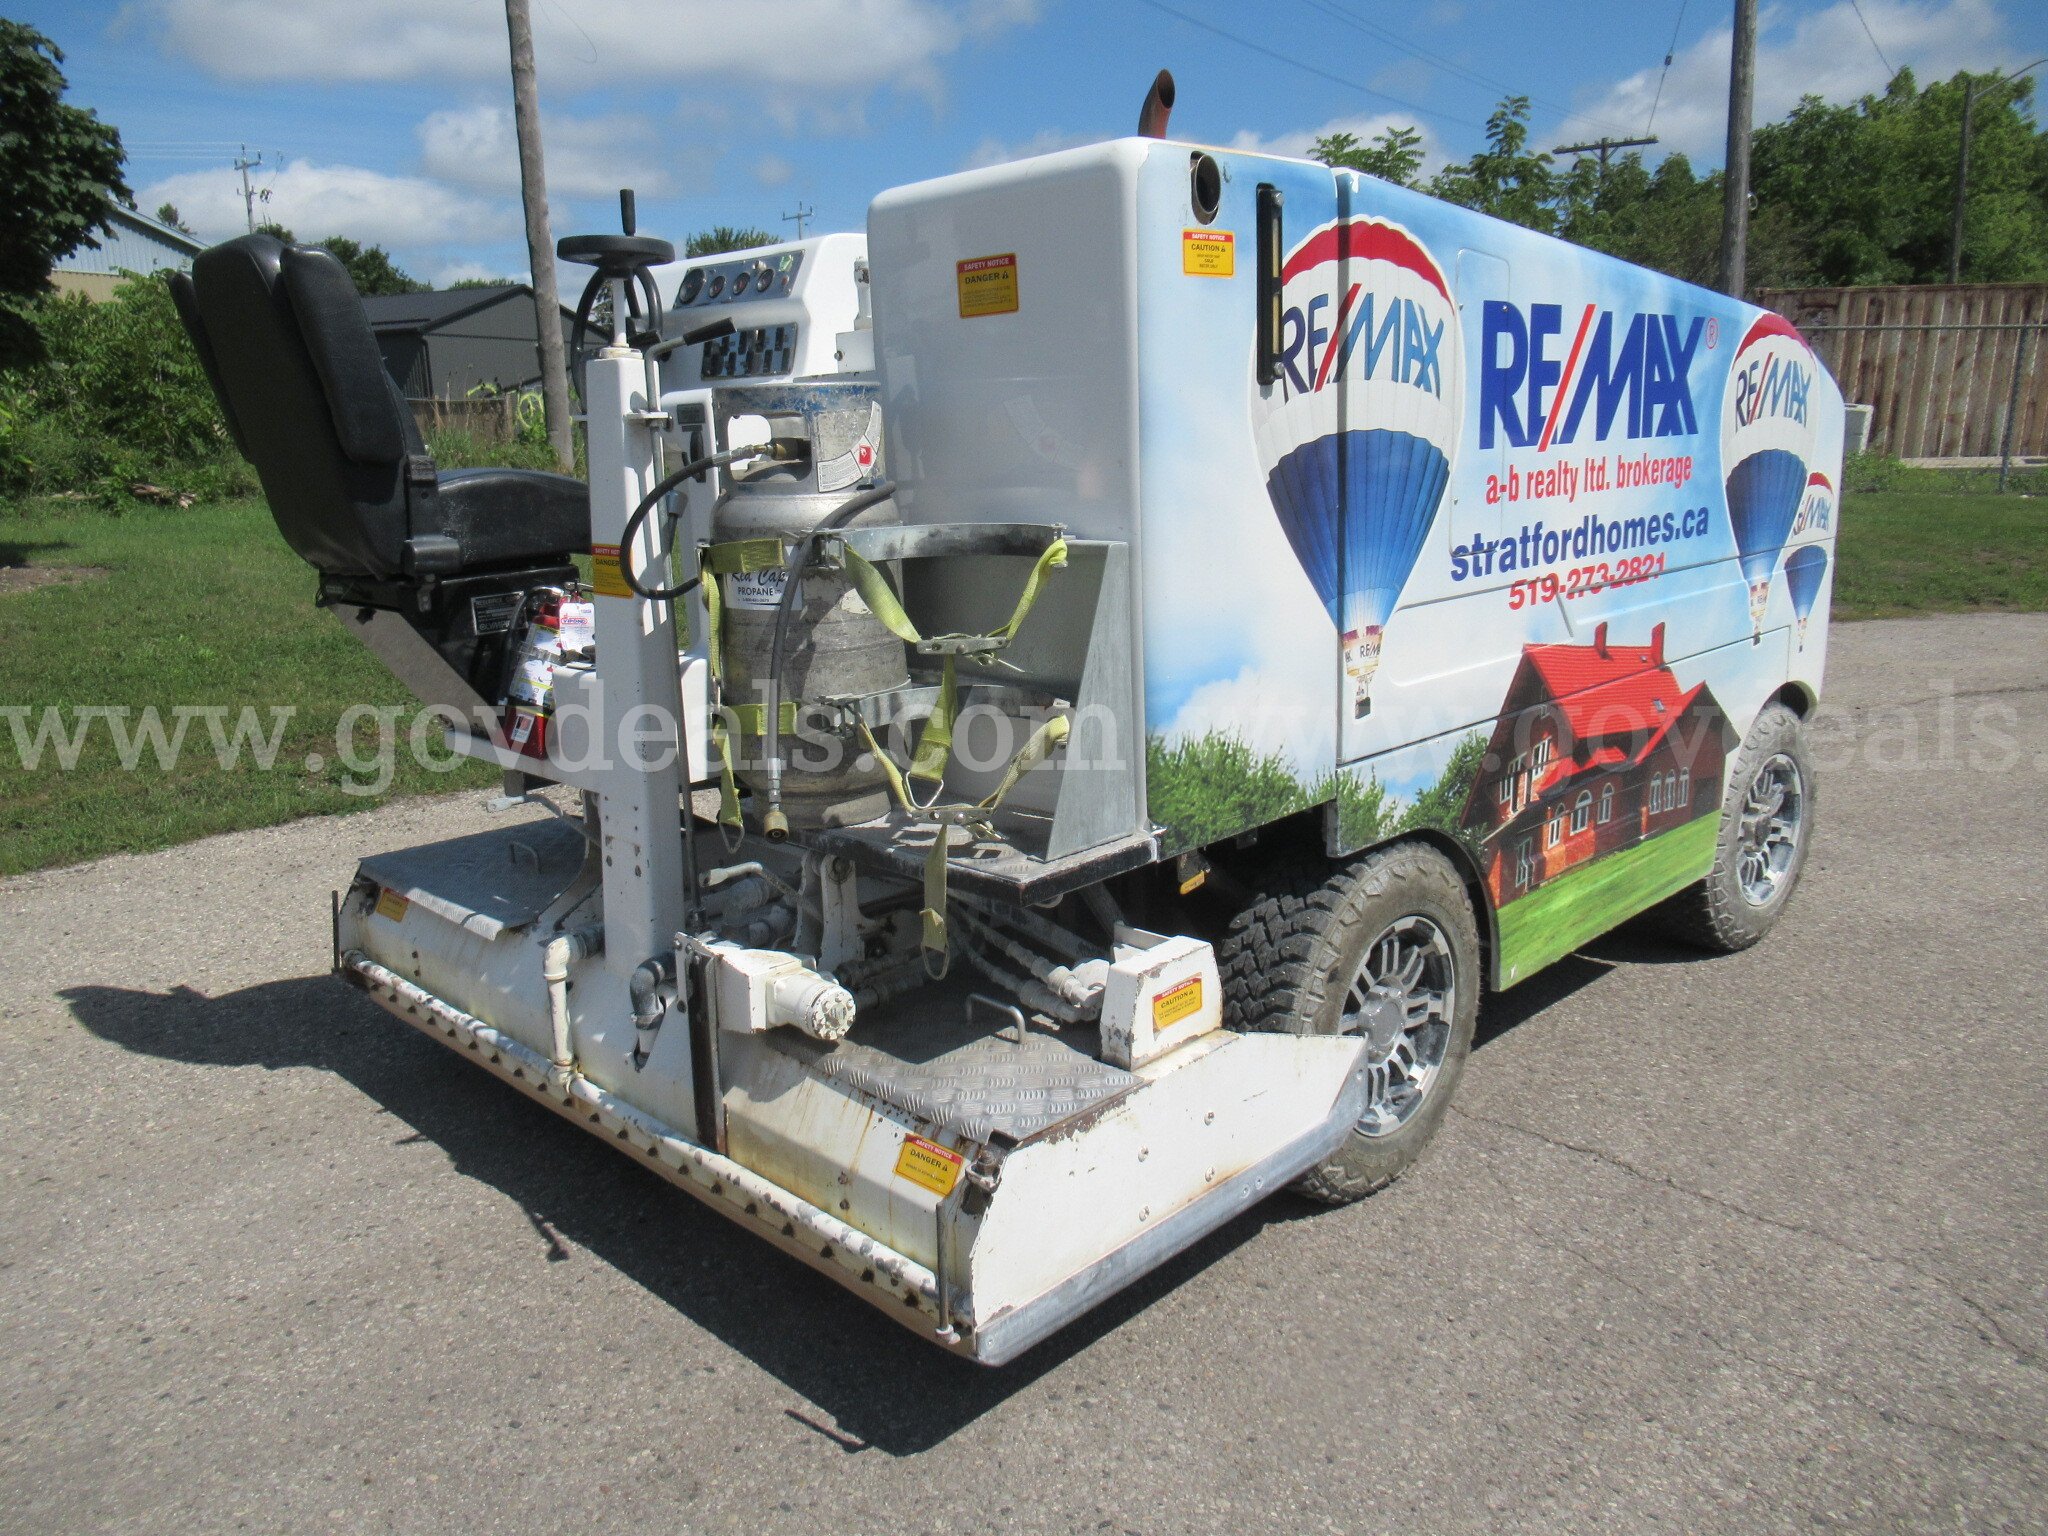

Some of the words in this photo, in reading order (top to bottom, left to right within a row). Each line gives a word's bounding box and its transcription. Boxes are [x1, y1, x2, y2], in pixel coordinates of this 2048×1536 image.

[1191, 243, 1220, 252] CAUTION
[964, 261, 986, 271] SAFETY
[987, 257, 1009, 268] NOTICE
[965, 272, 1000, 284] DANGER
[1282, 282, 1444, 404] RE/MAX
[1735, 351, 1811, 432] RE/MAX
[1485, 464, 1519, 505] a-b
[1526, 459, 1578, 503] realty
[1584, 456, 1610, 492] ltd.
[1616, 452, 1693, 490] brokerage
[1450, 505, 1709, 582] stratfordhomes.ca
[1508, 551, 1666, 610] 519-273-2821
[737, 586, 774, 597] PROPANE
[1160, 991, 1189, 1009] CAUTION
[910, 1148, 942, 1168] DANGER
[915, 1139, 935, 1152] SAFETY
[934, 1147, 953, 1160] NOTICE
